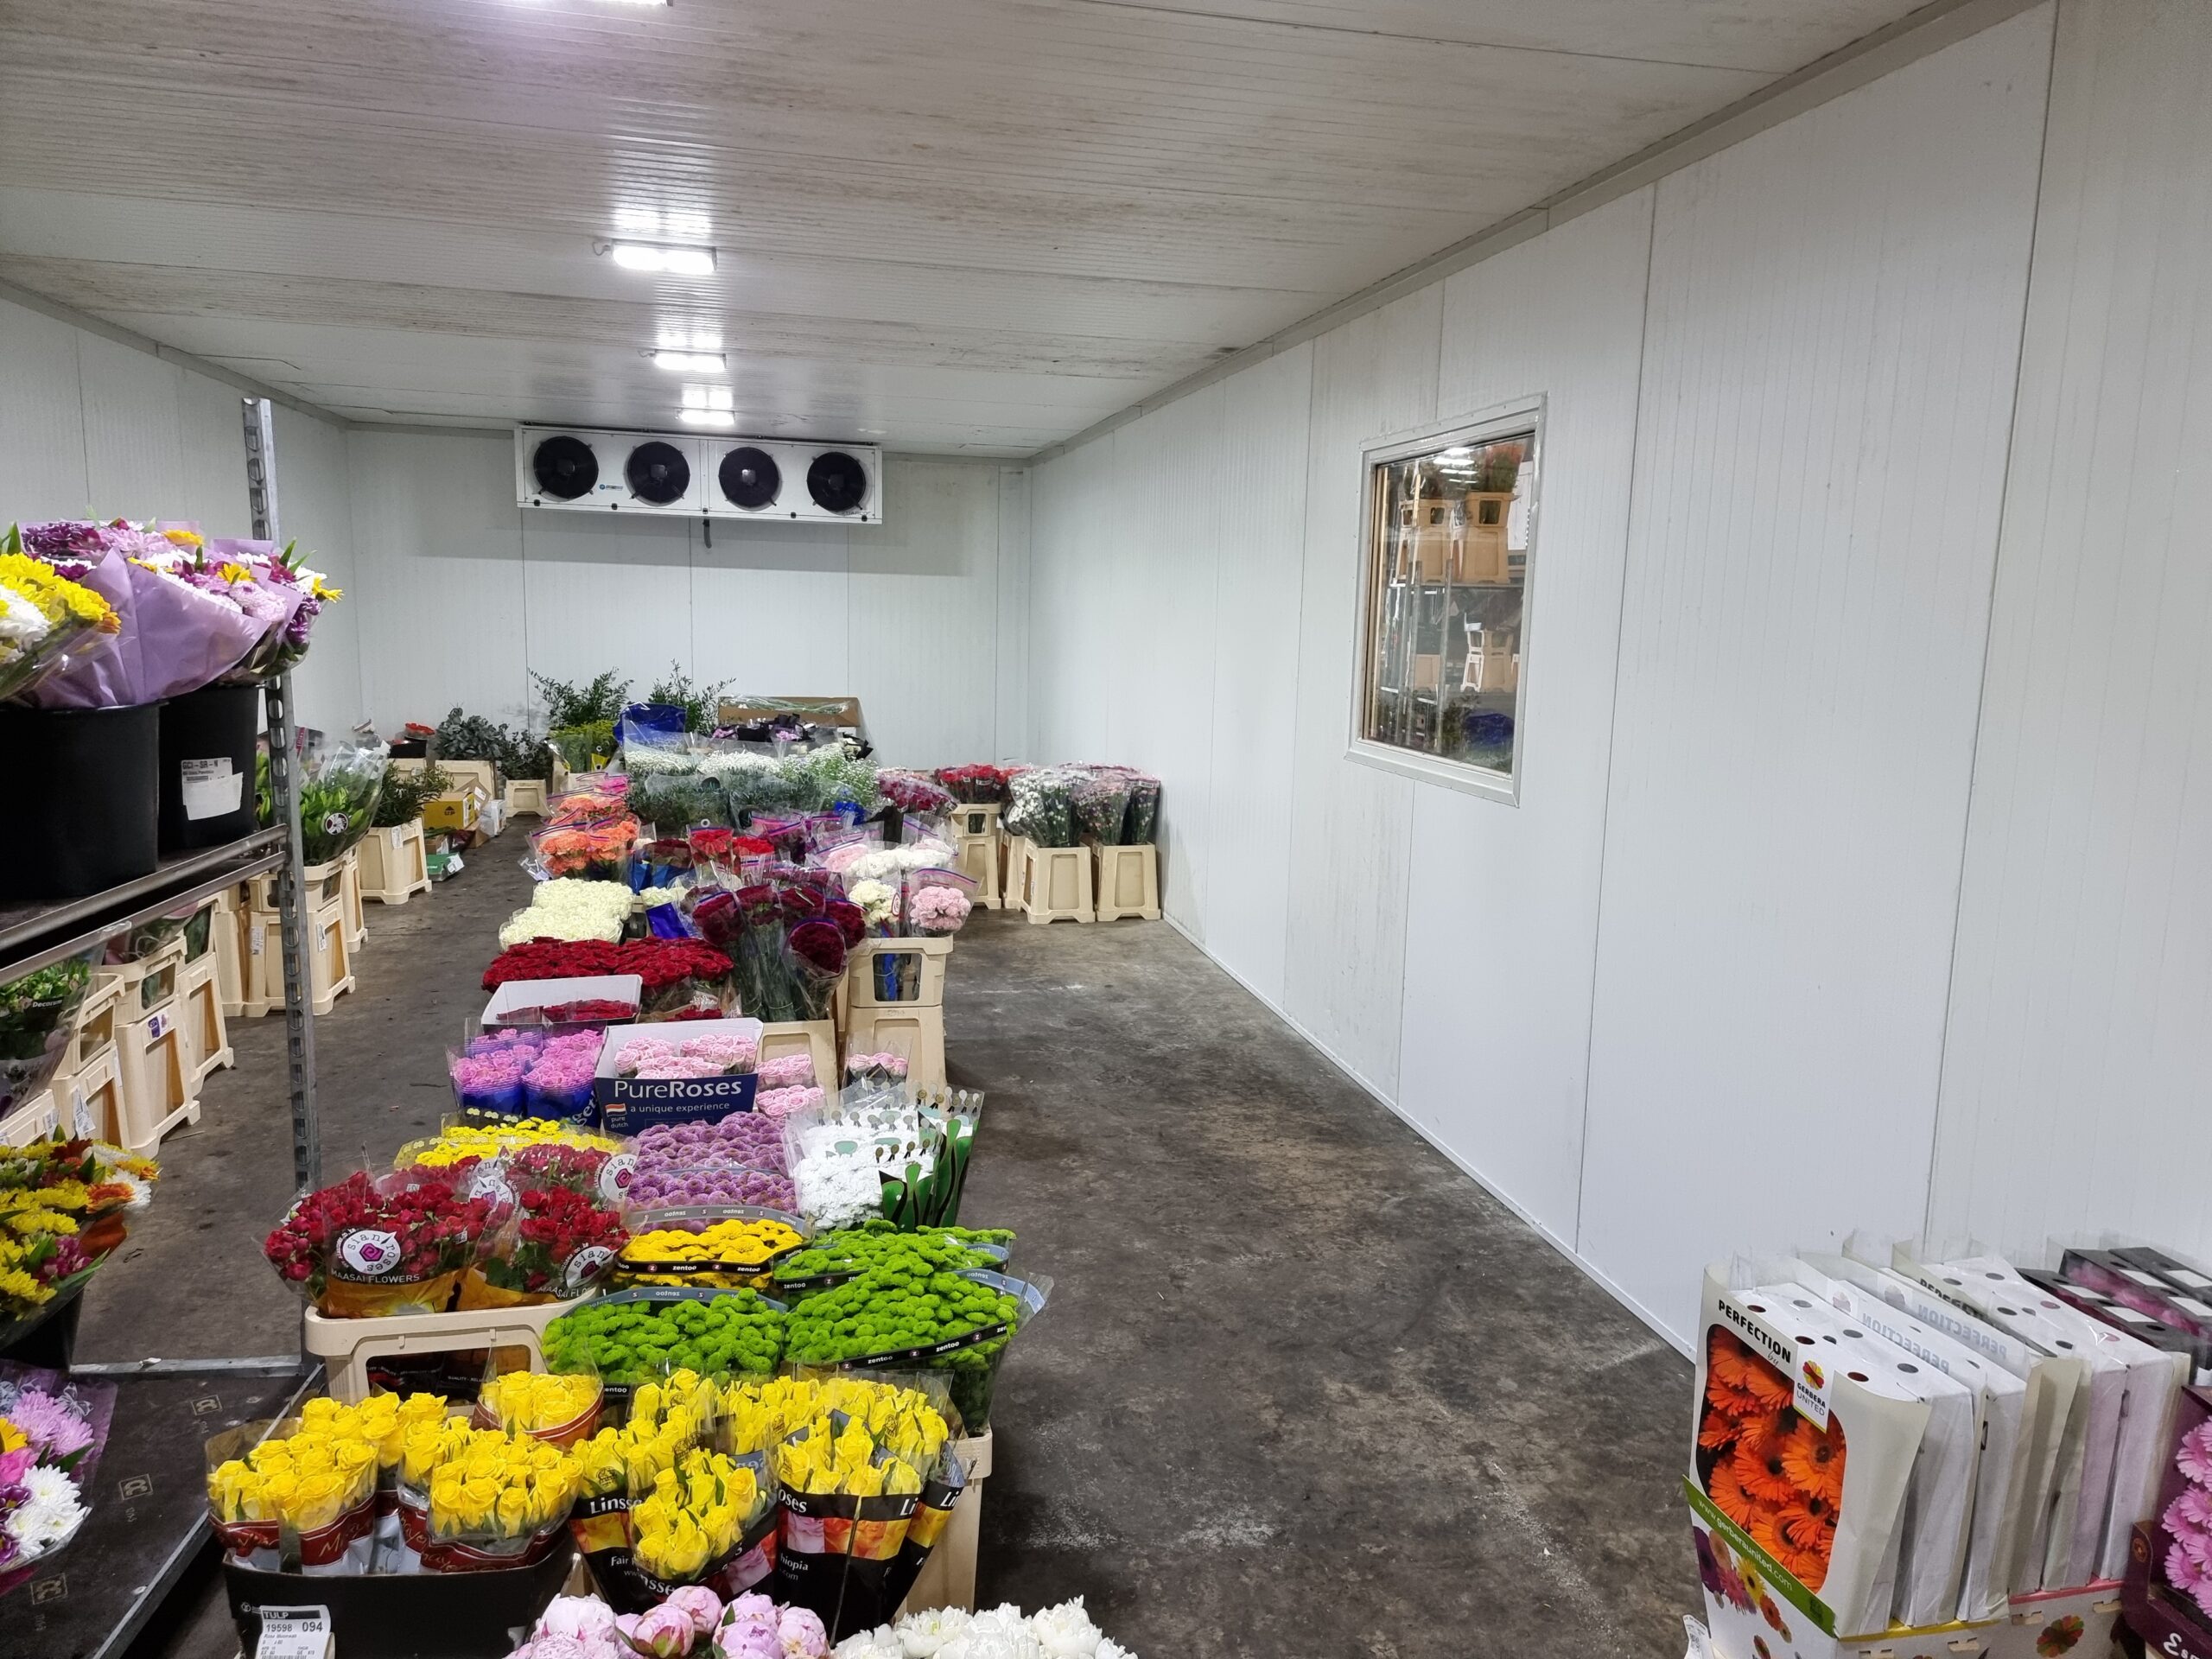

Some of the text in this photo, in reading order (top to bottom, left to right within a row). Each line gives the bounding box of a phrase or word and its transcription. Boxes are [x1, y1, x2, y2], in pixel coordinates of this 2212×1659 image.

[32, 999, 63, 1007] Decorum
[614, 1080, 742, 1098] PureRoses
[639, 1104, 673, 1114] unique
[676, 1102, 730, 1113] experience
[347, 1234, 380, 1250] sian
[367, 1244, 396, 1271] roses
[575, 1250, 605, 1268] sian
[331, 1268, 420, 1284] MAASAI FLOWERS
[538, 1286, 569, 1298] MAASAI
[1718, 1299, 1791, 1363] PERFECTION
[868, 1355, 893, 1364] zentoo
[936, 1341, 960, 1352] zentoo
[996, 1325, 1007, 1333] zen
[1767, 1350, 1780, 1367] by
[1796, 1391, 1826, 1417] UNITED
[1797, 1382, 1826, 1408] GERBERA
[779, 1487, 918, 1516] oses Li
[1698, 1498, 1793, 1592] www.gerberaunited.com
[611, 1556, 629, 1566] Fair
[780, 1552, 809, 1571] hiopia
[266, 1621, 323, 1632] 19598 094
